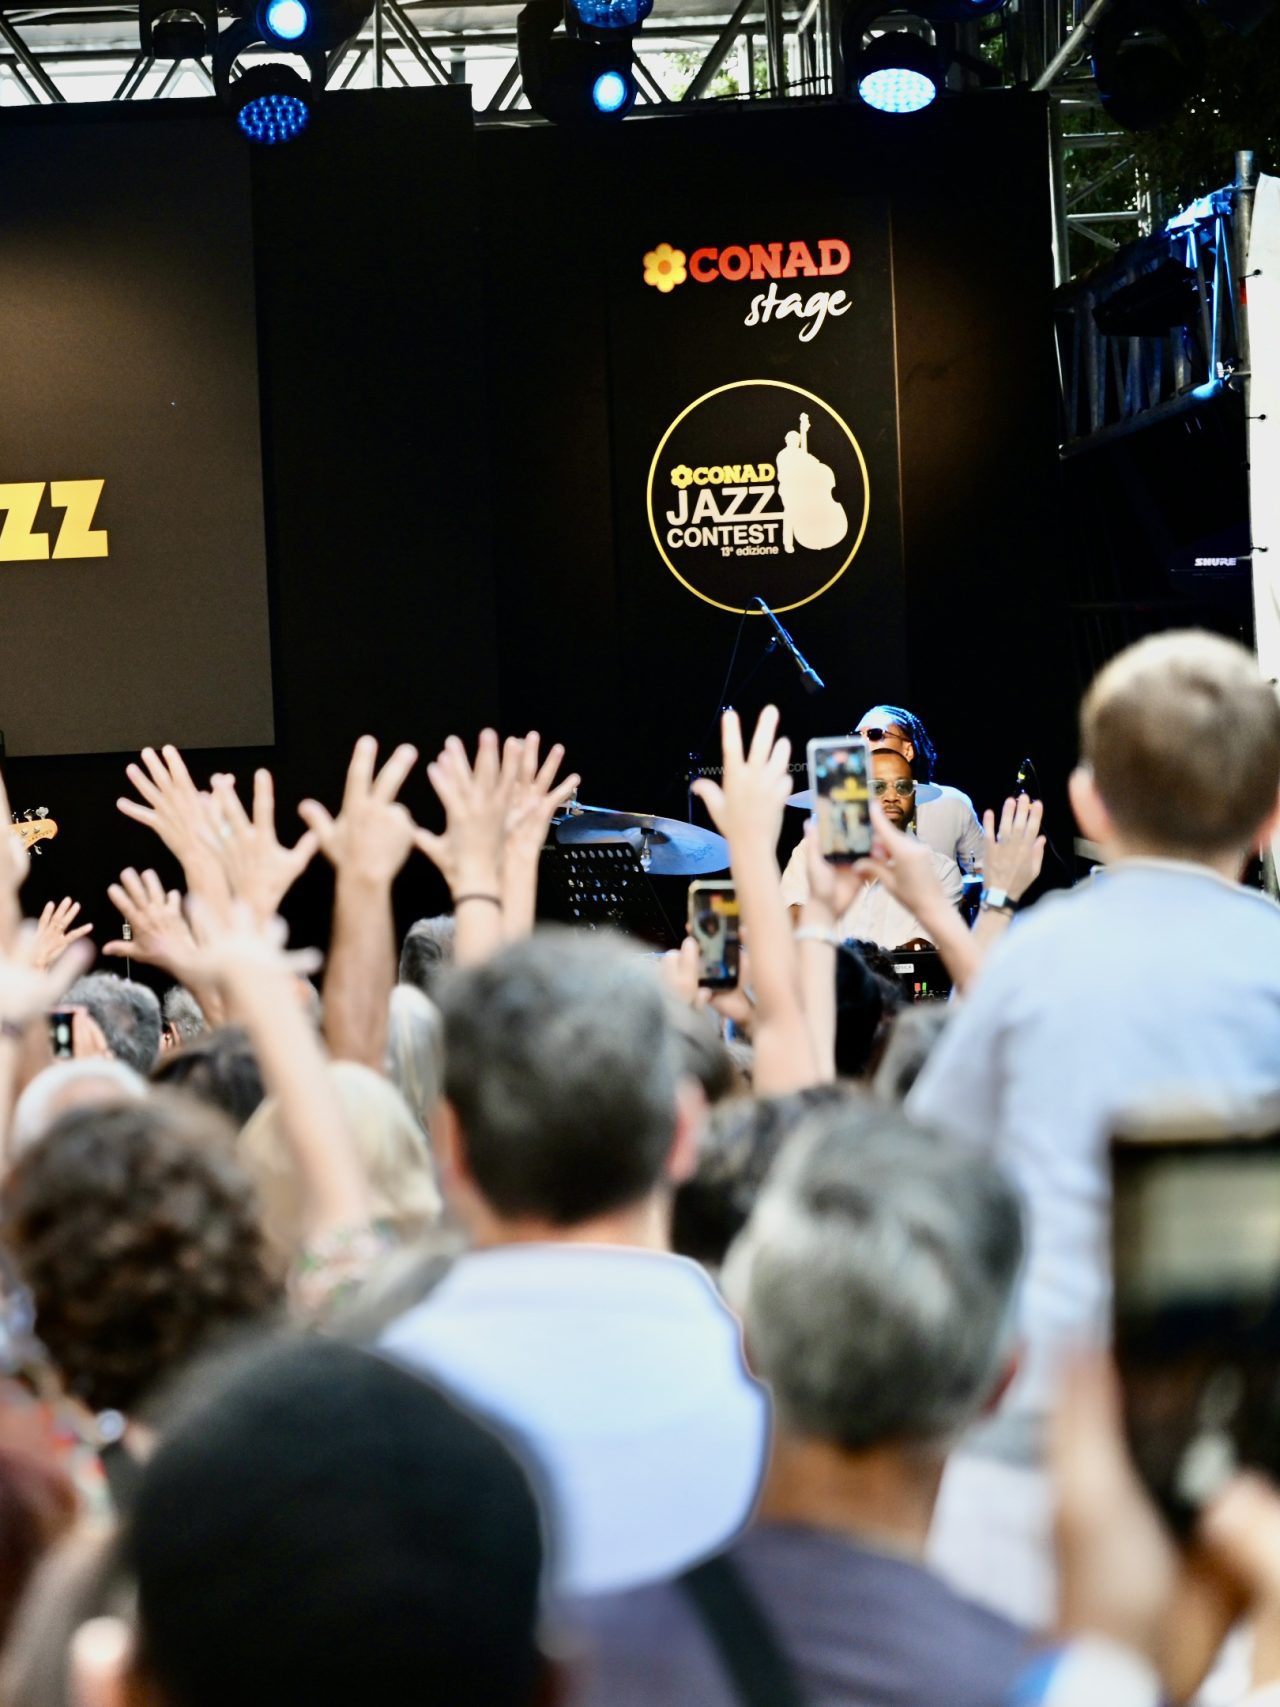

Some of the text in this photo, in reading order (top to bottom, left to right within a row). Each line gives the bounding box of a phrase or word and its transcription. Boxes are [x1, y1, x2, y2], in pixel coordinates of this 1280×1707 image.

[689, 239, 851, 283] CONAD
[743, 282, 853, 343] stage
[692, 463, 776, 486] CONAD
[666, 485, 777, 527] JAZZ
[667, 523, 779, 548] CONTEST
[735, 545, 779, 557] edizione
[1194, 557, 1237, 567] SHURE
